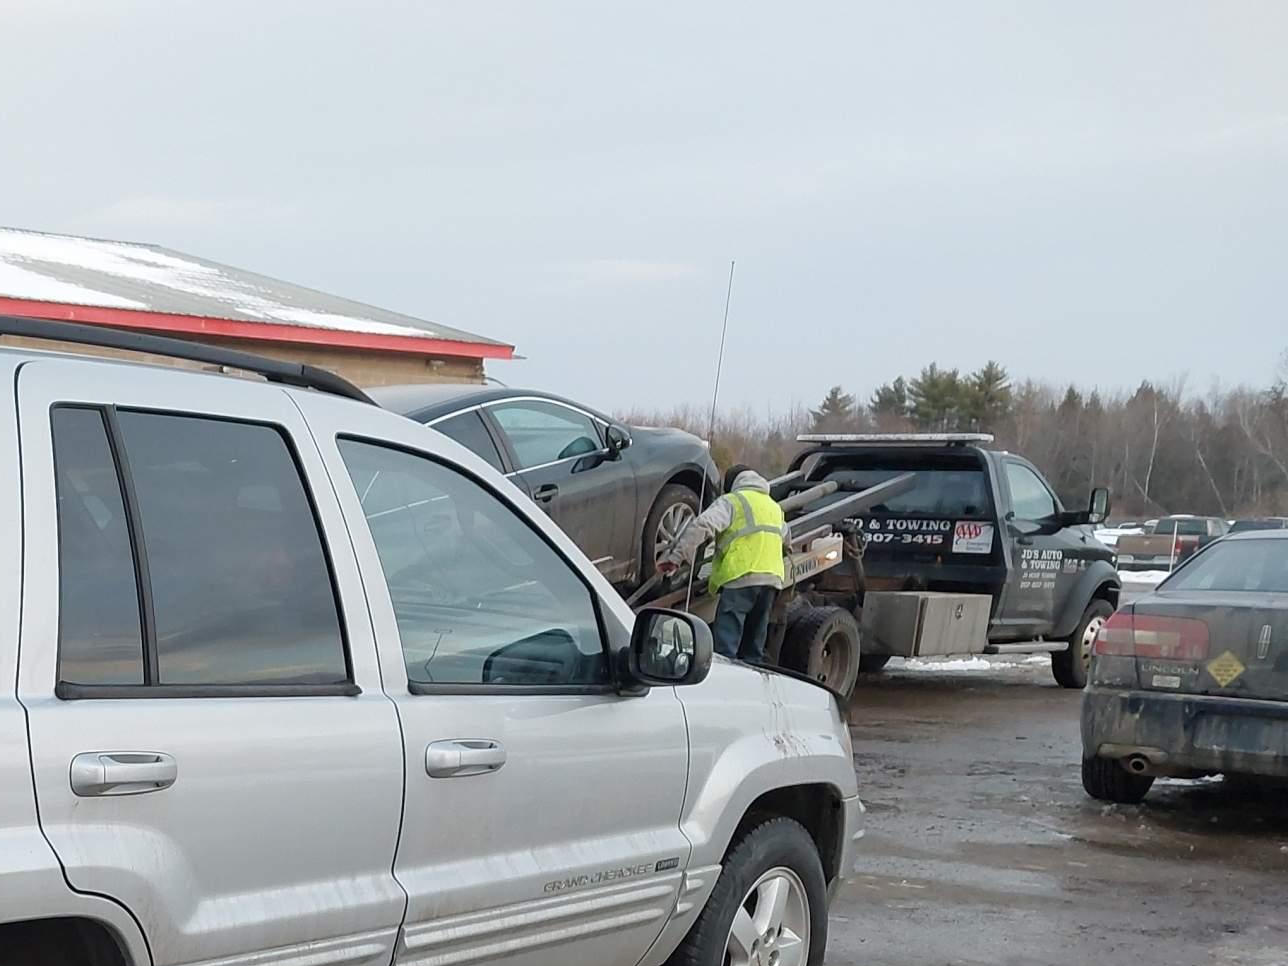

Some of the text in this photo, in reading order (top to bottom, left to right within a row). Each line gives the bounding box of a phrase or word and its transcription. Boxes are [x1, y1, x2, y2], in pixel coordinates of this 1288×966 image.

[869, 519, 880, 530] &
[886, 519, 951, 531] TOWING
[1041, 550, 1063, 560] AUTO
[1030, 560, 1061, 570] TOWING
[1141, 663, 1200, 675] LINCOLN
[543, 874, 588, 893] GRAND
